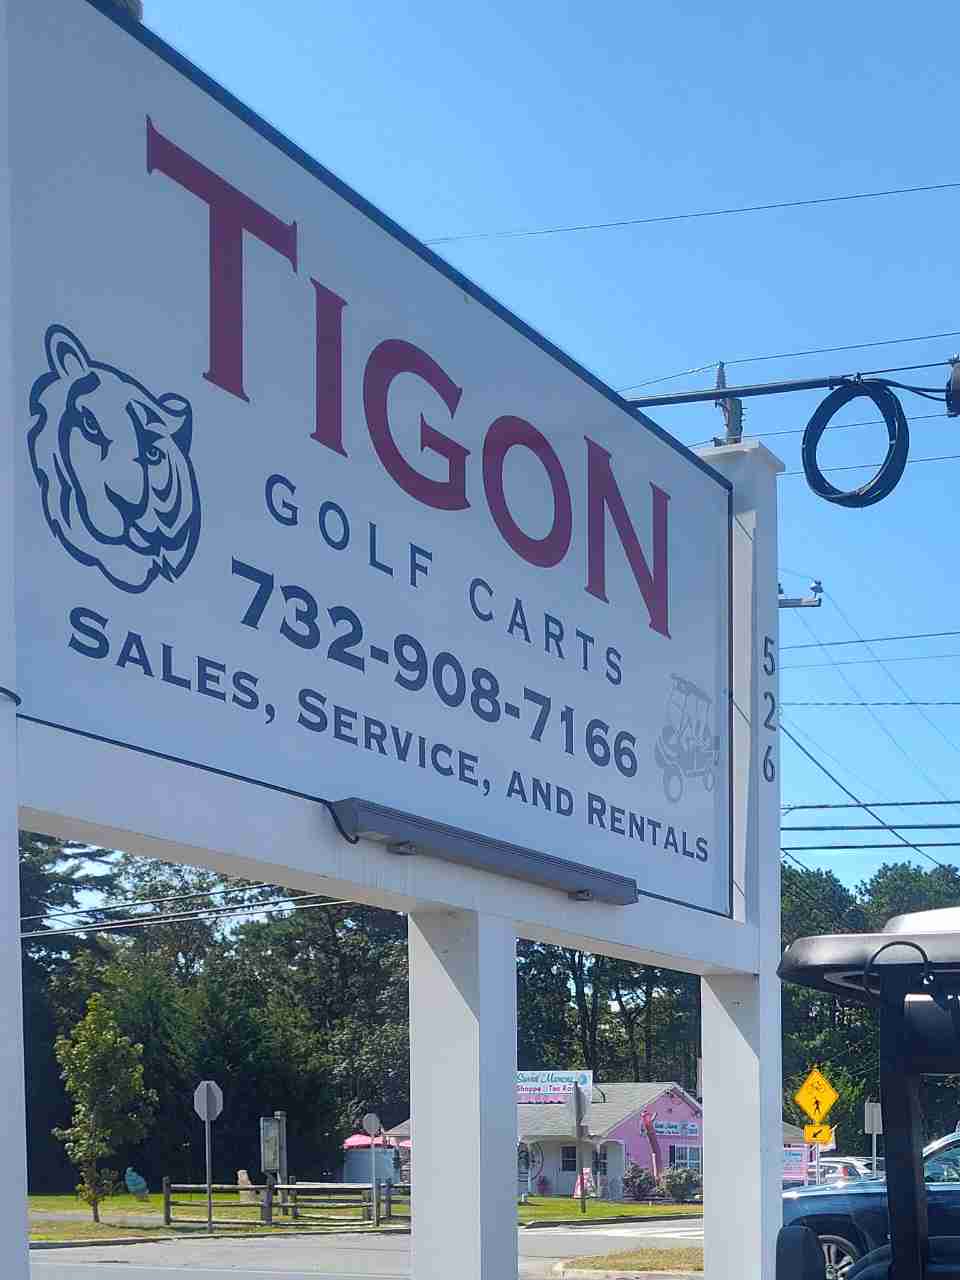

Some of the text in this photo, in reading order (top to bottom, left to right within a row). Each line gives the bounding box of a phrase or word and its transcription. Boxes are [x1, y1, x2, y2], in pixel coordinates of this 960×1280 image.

[146, 114, 671, 639] TIGON
[231, 555, 638, 778] 732-908-7166
[265, 474, 622, 686] GOLF CARTS
[68, 607, 710, 863] SALES, SERVICE, AND RENTALS
